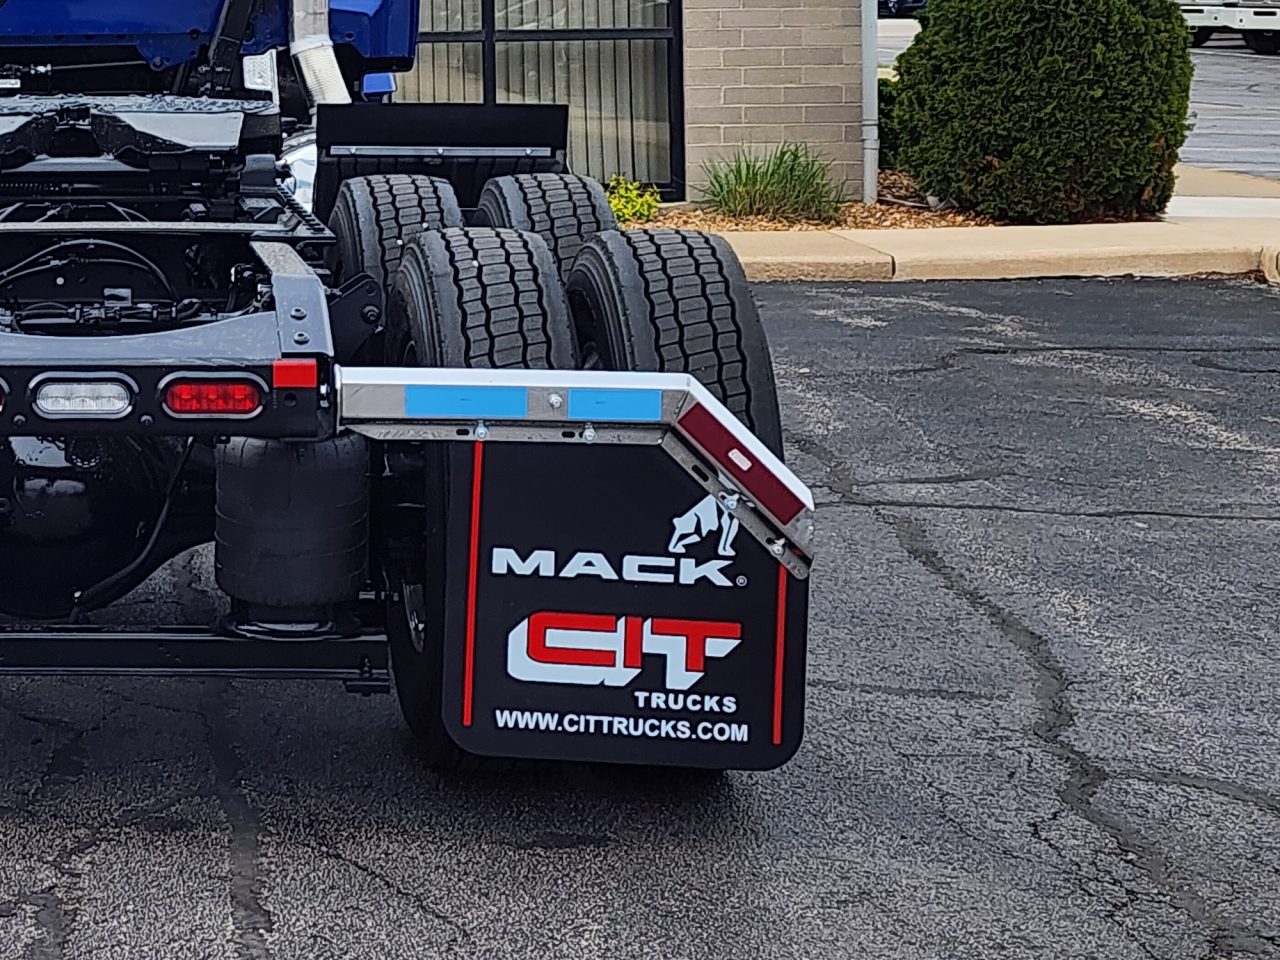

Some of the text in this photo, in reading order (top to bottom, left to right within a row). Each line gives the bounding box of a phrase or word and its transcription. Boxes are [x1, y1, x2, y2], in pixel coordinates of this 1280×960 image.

[491, 547, 735, 587] MACK
[525, 610, 742, 674] CIT
[633, 690, 737, 713] TRUCKS
[495, 709, 749, 742] WWW.CITTRUCKS.COM
